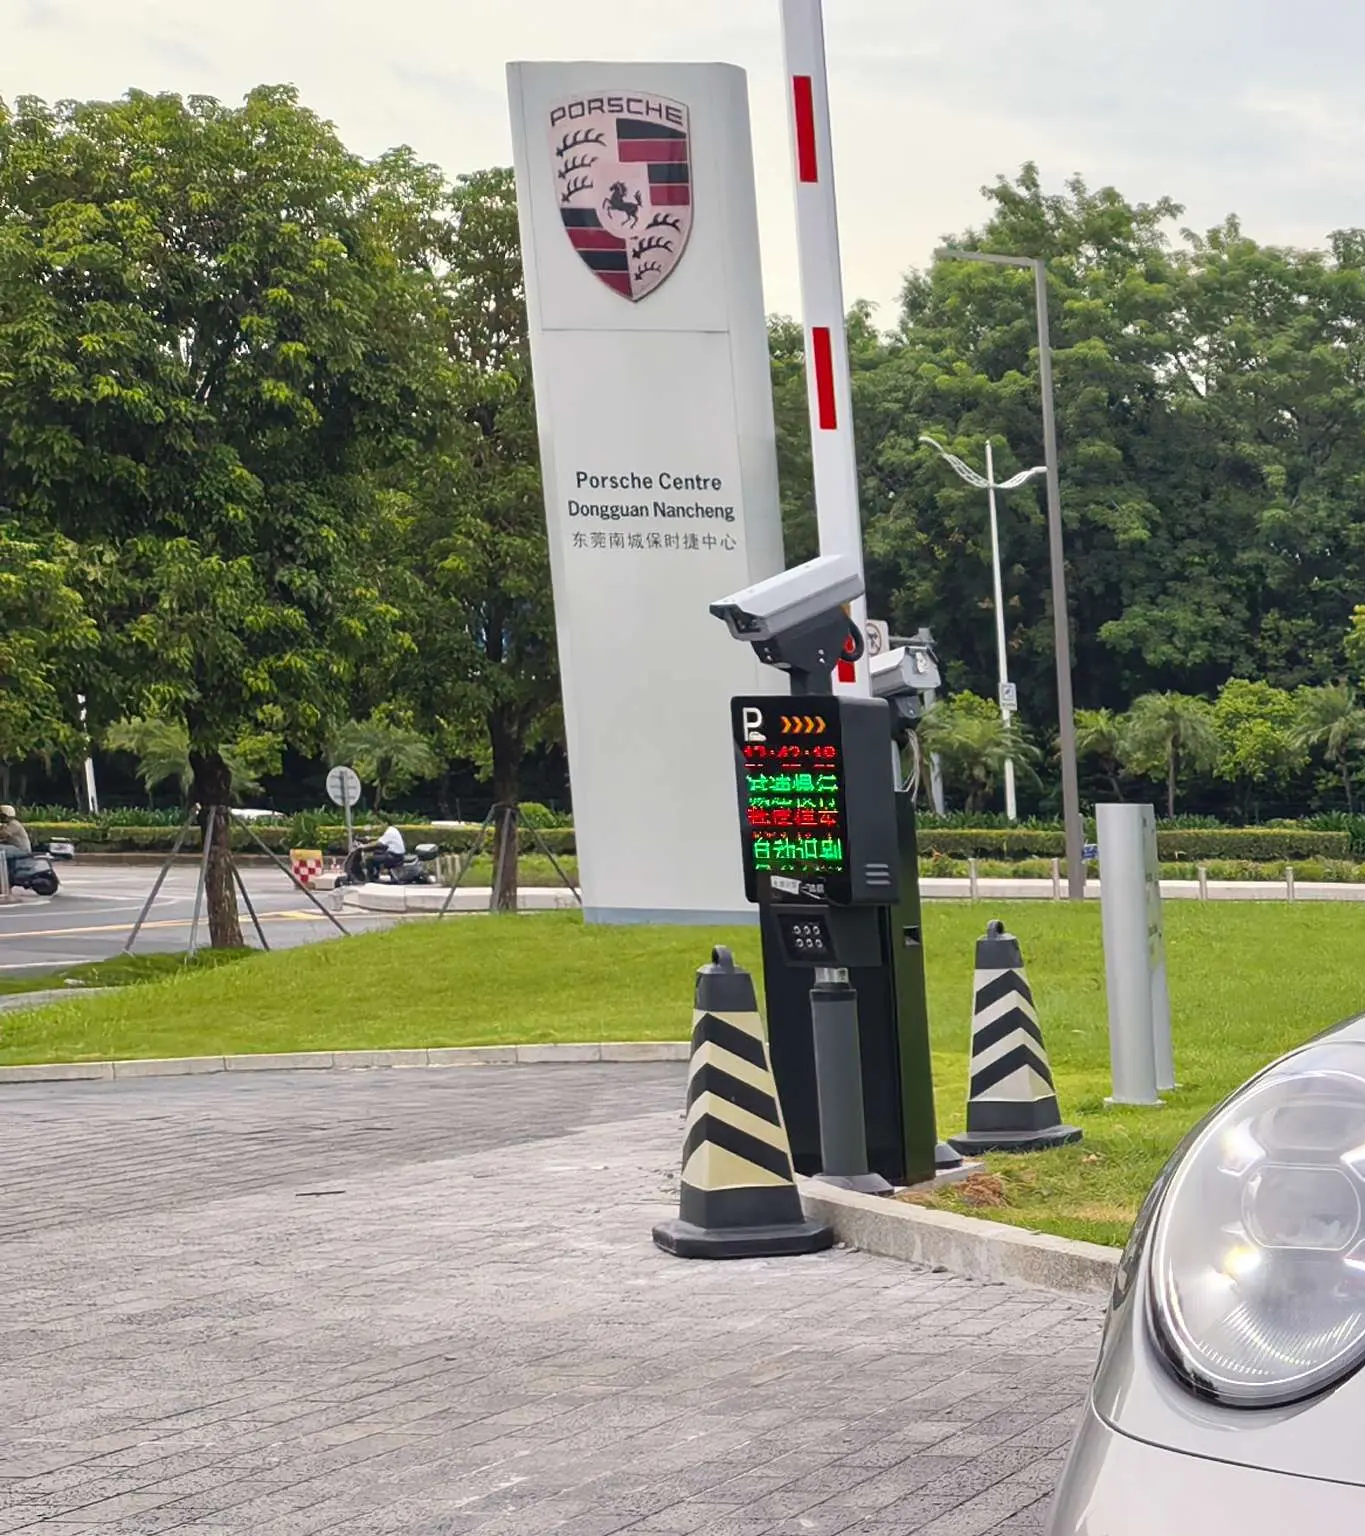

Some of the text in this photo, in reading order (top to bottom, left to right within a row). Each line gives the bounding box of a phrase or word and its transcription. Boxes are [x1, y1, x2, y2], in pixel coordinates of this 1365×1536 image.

[550, 97, 683, 127] PORSCHE
[576, 471, 722, 490] Porsche Centre
[568, 500, 735, 522] Dongguan Nancheng
[572, 531, 737, 550] 东莞南城保时捷中心
